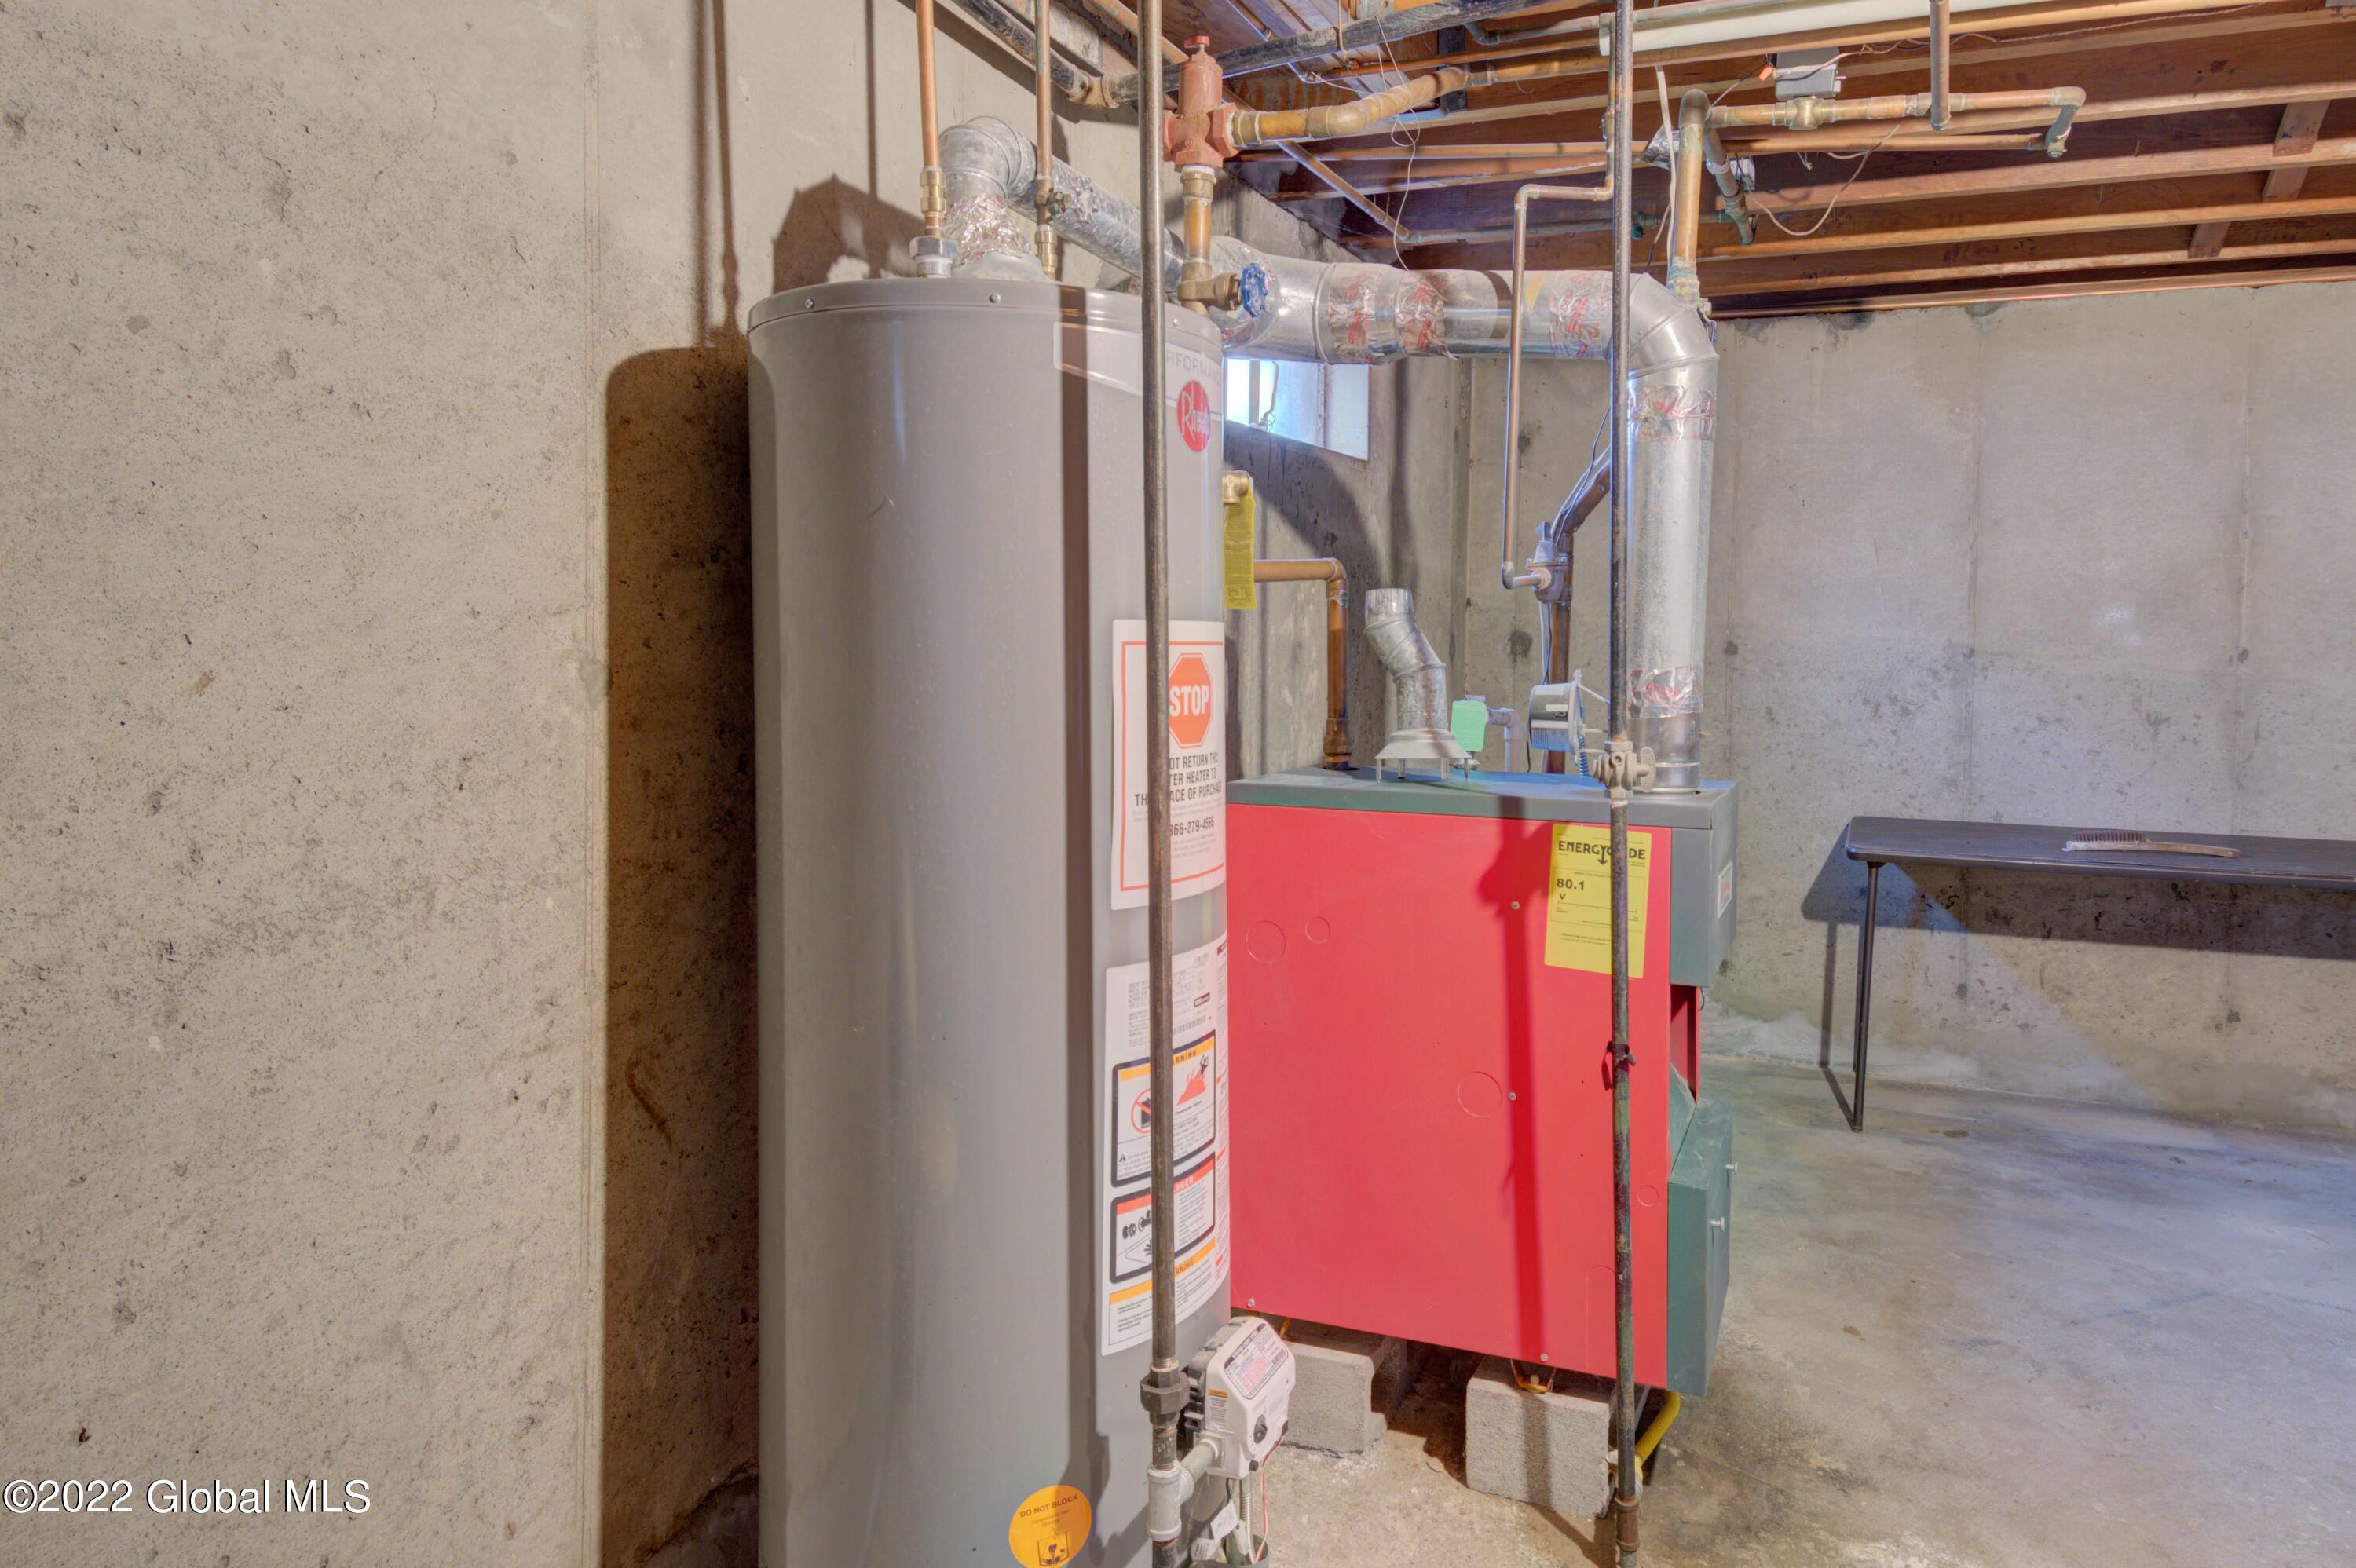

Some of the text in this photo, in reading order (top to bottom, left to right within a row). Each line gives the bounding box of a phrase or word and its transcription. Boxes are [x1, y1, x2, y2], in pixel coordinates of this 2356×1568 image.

[1166, 350, 1221, 385] RFORMAN
[1169, 685, 1209, 716] STOP
[1169, 758, 1180, 769] OT
[1183, 754, 1209, 769] RETURN
[1169, 773, 1183, 785] TER
[1186, 768, 1209, 784] HEATER
[1134, 780, 1222, 806] TH ACE OF PURCHASE
[1558, 841, 1646, 862] ENERGYDE
[1557, 879, 1584, 890] 80.1
[1173, 1047, 1197, 1065] RNING
[1173, 1175, 1194, 1193] NGER
[1175, 1259, 1194, 1276] RNING
[1033, 1504, 1050, 1514] NOT
[1052, 1494, 1078, 1508] BLOCK
